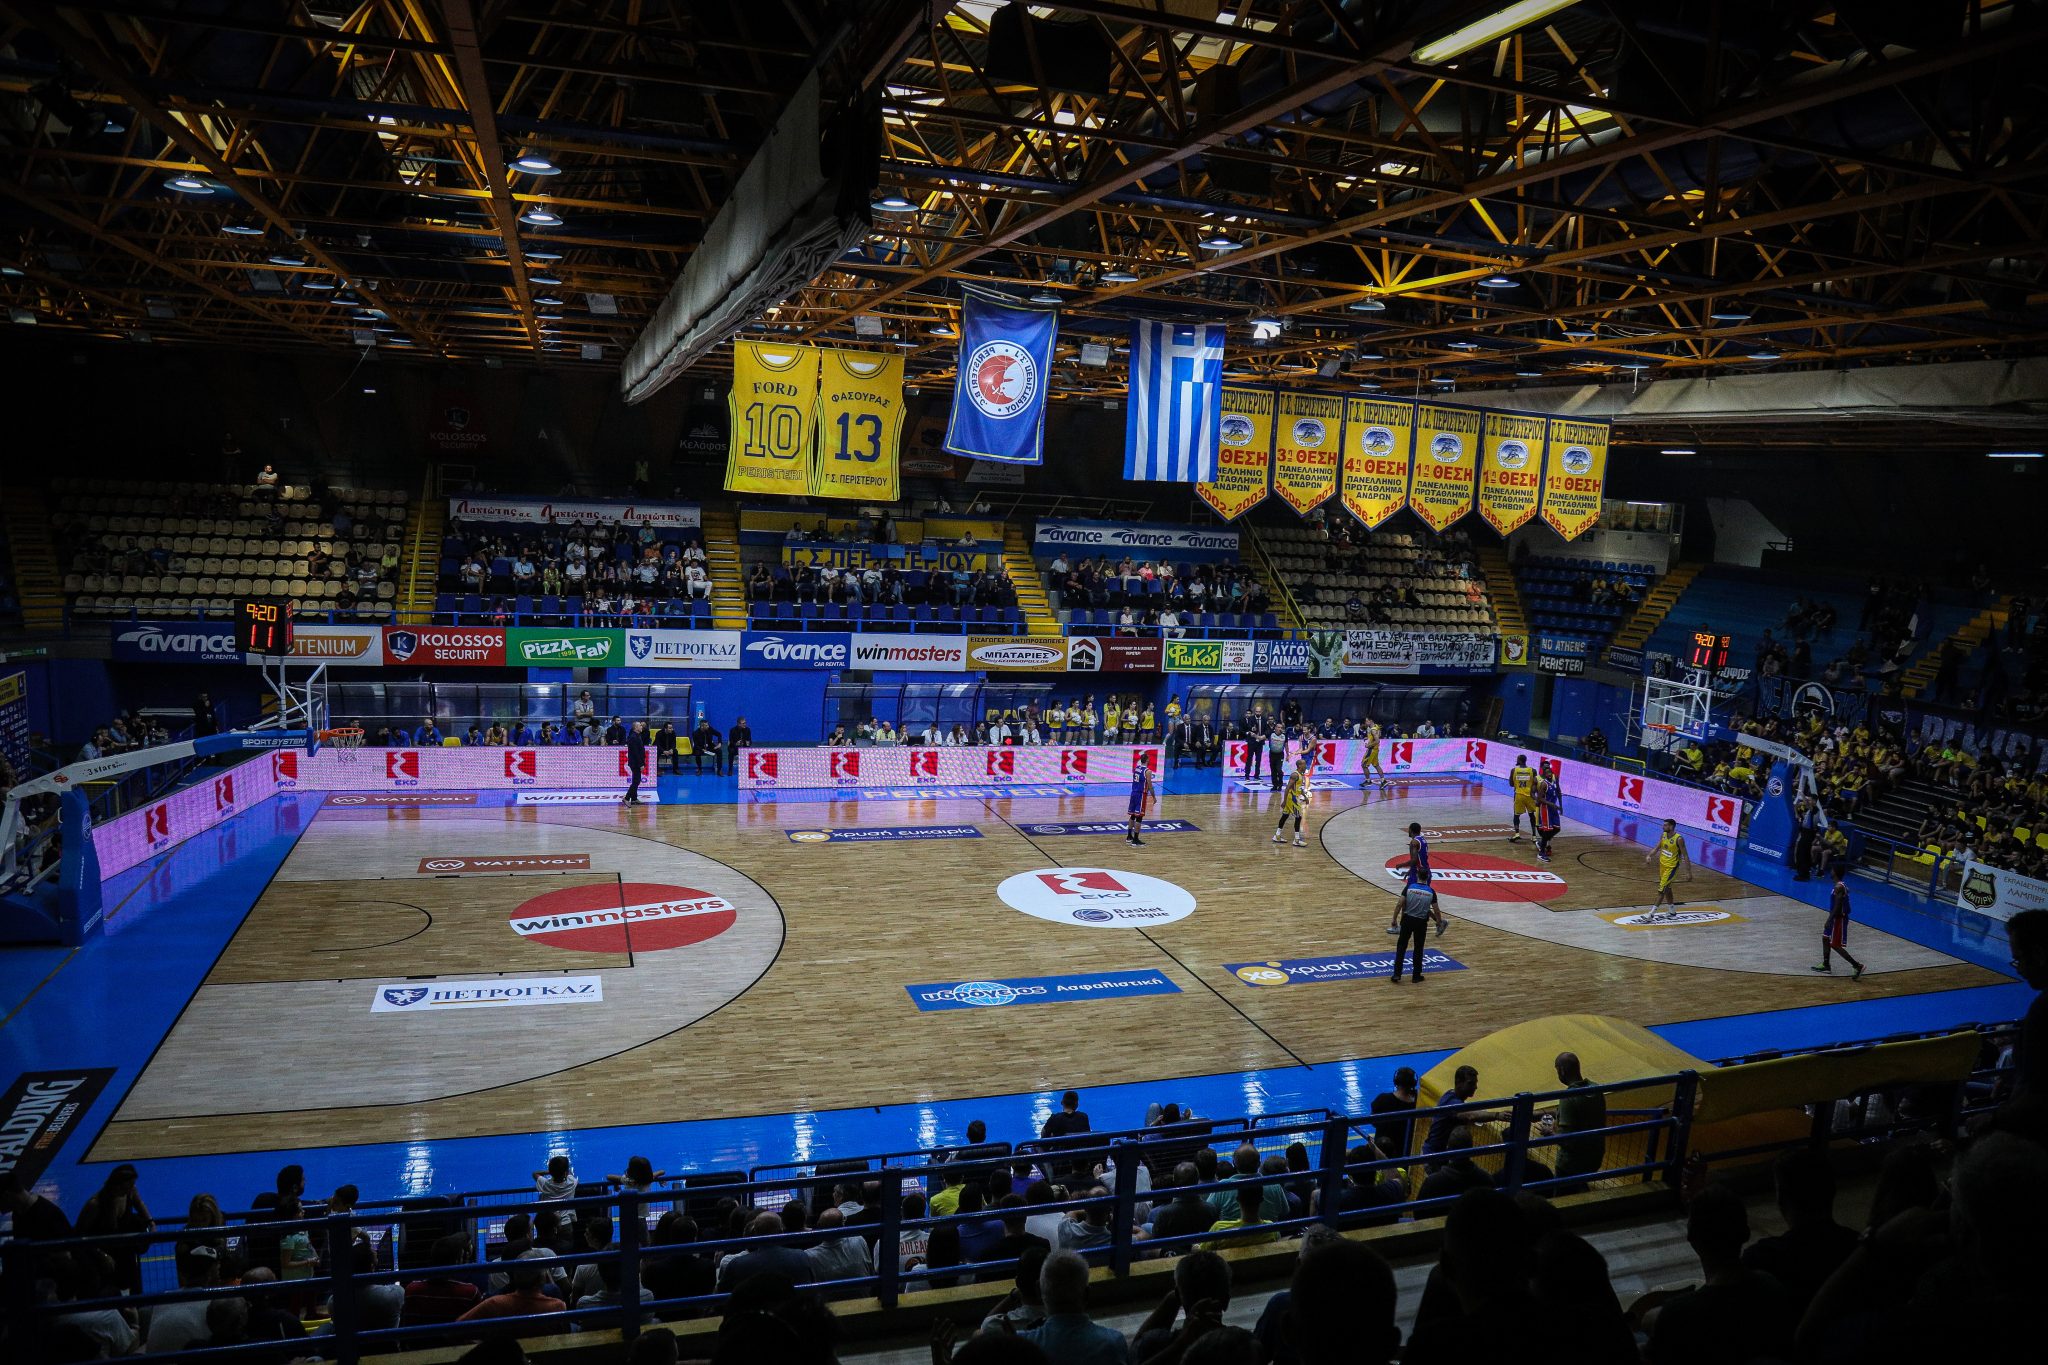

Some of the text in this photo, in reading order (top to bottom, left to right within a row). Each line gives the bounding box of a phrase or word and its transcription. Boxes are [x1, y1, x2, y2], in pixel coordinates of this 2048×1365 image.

[752, 382, 798, 397] FORD
[831, 392, 891, 409] ΦΑΣΟΥΡΑΣ
[1294, 396, 1341, 419] ΠΕΡΙΣΤΕΡΙΟΥ
[1363, 402, 1412, 427] ΠΕΡΙΣΤΕΡΙΟΥ
[1433, 409, 1479, 434] ΠΕΡΙΣΤΕΡΙΟΥ
[744, 402, 802, 459] 10
[1499, 416, 1545, 440] ΠΕΡΙΣΤΕΡΙΟΥ
[1564, 423, 1608, 447] ΠΕΡΙΣΤΕΡΙΟΥ
[429, 432, 488, 443] KOLOSSOS
[834, 412, 883, 463] 13
[1220, 448, 1267, 467] ΘΕΣΗ
[1296, 449, 1337, 467] ΘΕΣΗ
[738, 466, 803, 481] PERISTERI
[1217, 466, 1263, 478] ΝΕΛΛΗΝΙΟ
[1279, 465, 1333, 476] ΠΑΝΕΛΛΗΝΙΟ
[1364, 460, 1407, 476] ΘΕΣΗ
[1433, 465, 1473, 482] ΘΕΣΗ
[840, 475, 887, 487] ΠΕΡΙΣΤΕΡΙΟΥ
[1216, 475, 1263, 485] ΩΤΑΘΛΗΜΑ
[1278, 473, 1333, 484] ΠΡΩΤΑΘΛΗΜΑ
[1288, 481, 1322, 490] ΑΝΔΡΩΝ
[1346, 475, 1402, 486] ΠΑΝΕΛΛΗΝΙΟ
[1499, 471, 1538, 487] ΘΕΣΗ
[1564, 477, 1601, 493] ΘΕΣΗ
[1212, 483, 1250, 492] ΑΝΔΡΩΝ
[1345, 483, 1403, 494] ΠΡΩΤΑΘΛΗΜΑ
[1414, 488, 1470, 499] ΠΡΩΤΑΘΛΗΜΑ
[1417, 481, 1469, 492] ΠΑΝΕΛΛΗΝΙΟ
[1483, 486, 1534, 497] ΠΑΝΕΛΛΗΝΙΟ
[1356, 492, 1391, 501] ΑΝΔΡΩΝ
[1424, 497, 1459, 506] ΕΦΗΒΩΝ
[1481, 493, 1535, 504] ΠΡΩΤΑΘΛΗΜΑ
[1548, 492, 1597, 503] ΠΑΝΕΛΛΗΝΙΟ
[1492, 502, 1525, 511] ΕΦΗΒΩΝ
[1546, 499, 1597, 510] ΠΡΩΤΑΘΛΗΜΑ
[1557, 508, 1586, 516] ΠΑΙΔΩΝ
[1049, 528, 1103, 543] avance
[1121, 530, 1172, 546] avance
[1188, 533, 1237, 549] avance
[246, 603, 278, 622] 9:20
[139, 633, 236, 653] avance
[421, 634, 504, 648] KOLOSSOS
[1541, 638, 1586, 653] NO ATHENS
[1695, 633, 1716, 648] 9:20
[434, 649, 490, 661] SECURITY
[655, 641, 737, 656] ΠΕΤΡΟΓΚΑΖ
[763, 643, 846, 661] avance
[856, 643, 962, 662] winmasters
[985, 651, 1049, 660] ΜΠΑΤΑΡΙΕΣ
[1458, 653, 1481, 662] 1980
[1539, 655, 1584, 672] PERISTERI
[523, 793, 652, 801] winmasts
[862, 788, 1076, 799] PERISTERI
[1622, 801, 1640, 810] EKO
[832, 829, 893, 838] χρυσή
[899, 828, 975, 836] ευκαιρία
[1711, 823, 1730, 832] EKO
[153, 838, 169, 850] EKO
[473, 858, 588, 867] WATT+VOLT
[1391, 868, 1556, 881] wnmasters
[1079, 892, 1132, 900] EKO
[1963, 889, 1994, 905] ΛΑΜΠΙΡΗ
[2007, 888, 2046, 904] ΛΑΜΠΙΡΗ
[515, 898, 725, 931] winmasters
[1112, 907, 1164, 915] Basket
[1118, 912, 1170, 922] League
[1284, 961, 1358, 976] χρυσή
[1360, 954, 1450, 969] ευκαρία
[1056, 977, 1164, 992] Ασφαλιστική
[433, 983, 596, 1001] ΠΕΤΡΟΓΚΑΖ
[0, 1079, 87, 1176] ALDING
